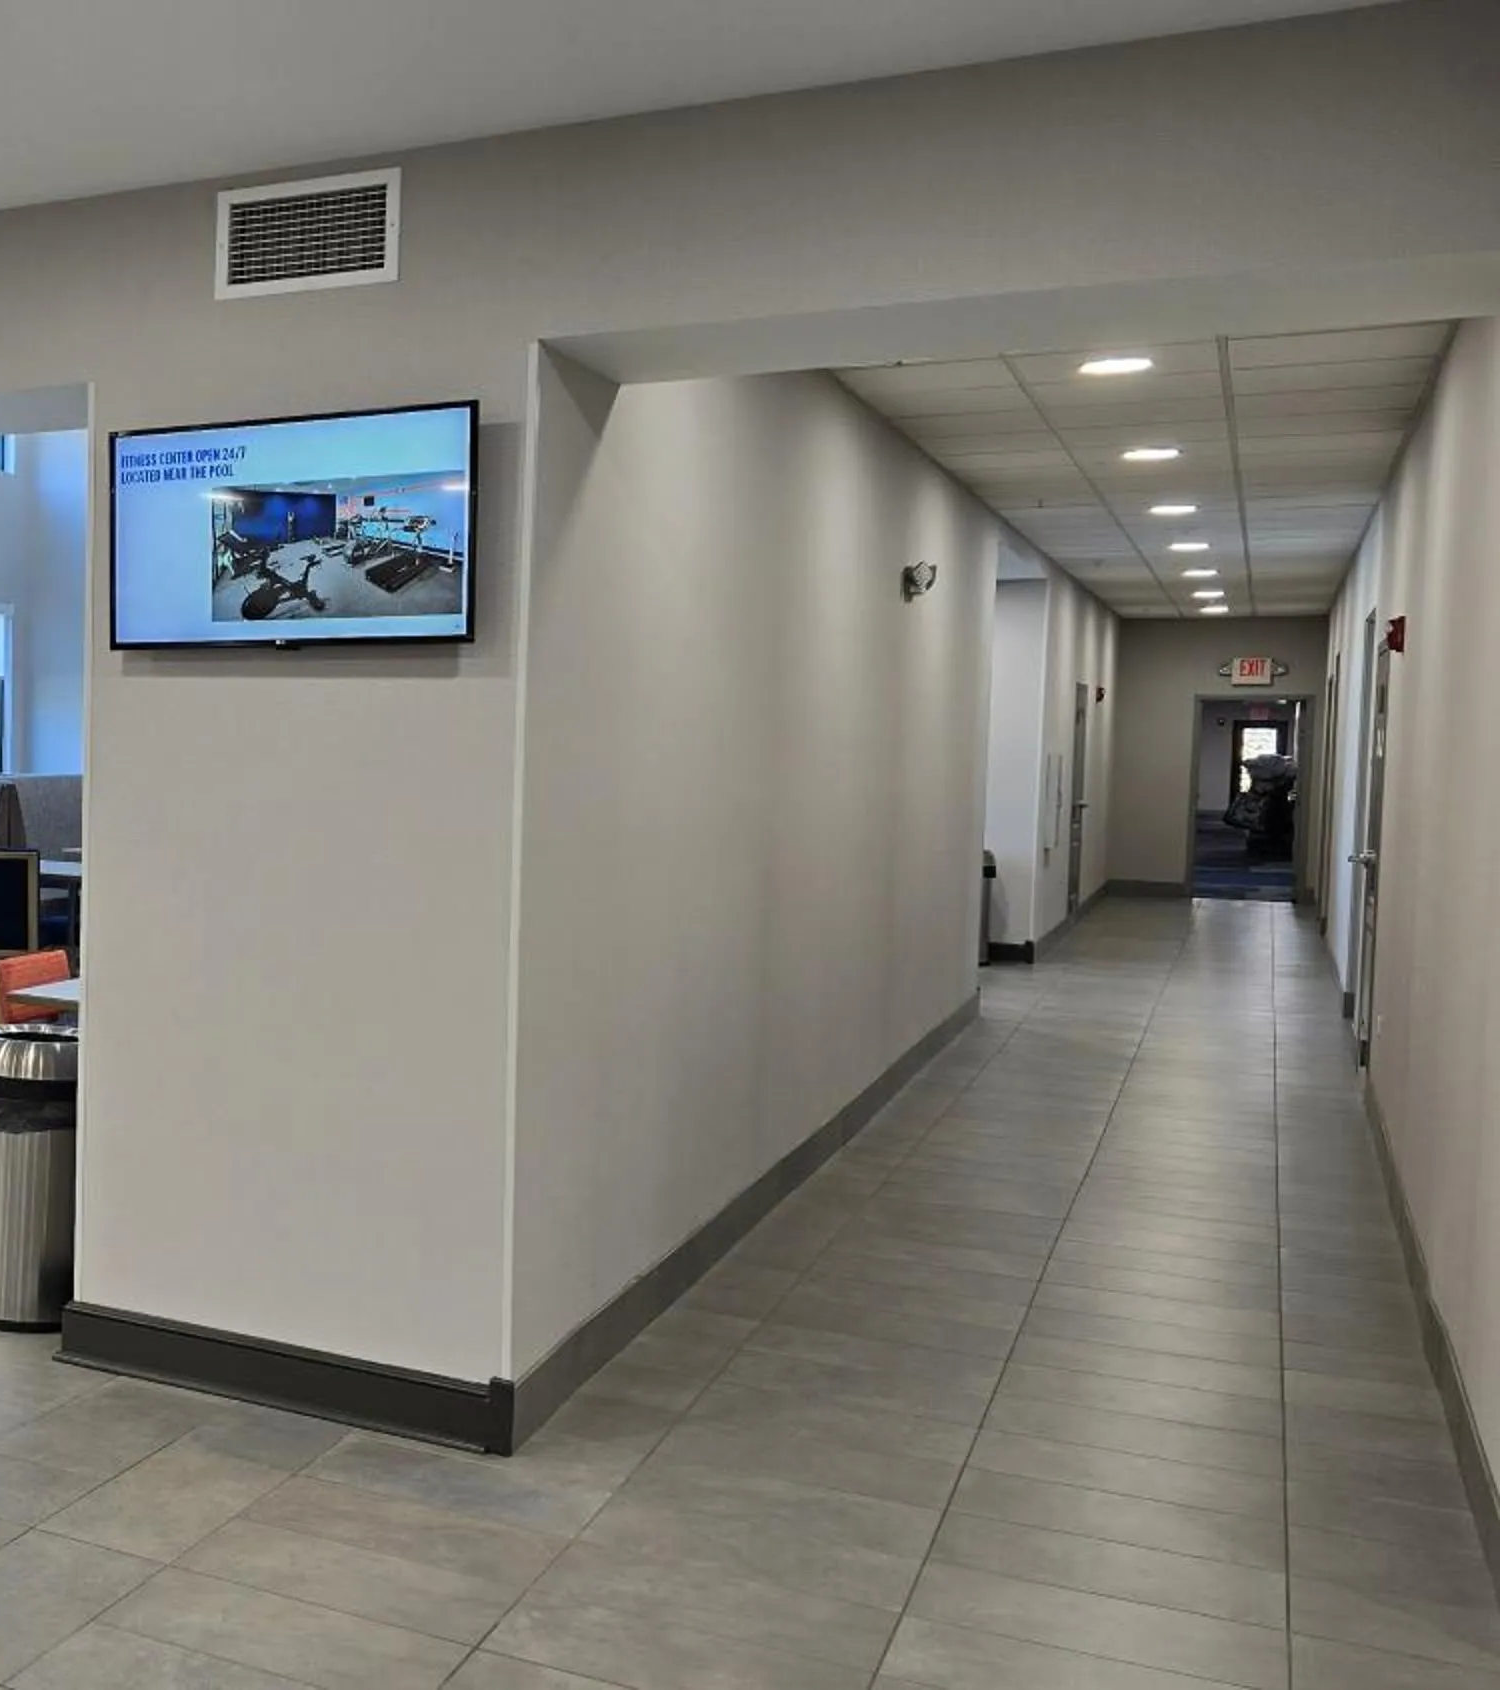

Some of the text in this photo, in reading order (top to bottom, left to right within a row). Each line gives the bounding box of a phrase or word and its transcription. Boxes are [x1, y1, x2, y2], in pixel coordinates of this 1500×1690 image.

[121, 445, 246, 468] FITNESS CENTER OPEN 24/7
[121, 463, 234, 484] LOCATED NEAR THE POOL
[1240, 659, 1267, 676] EXIT
